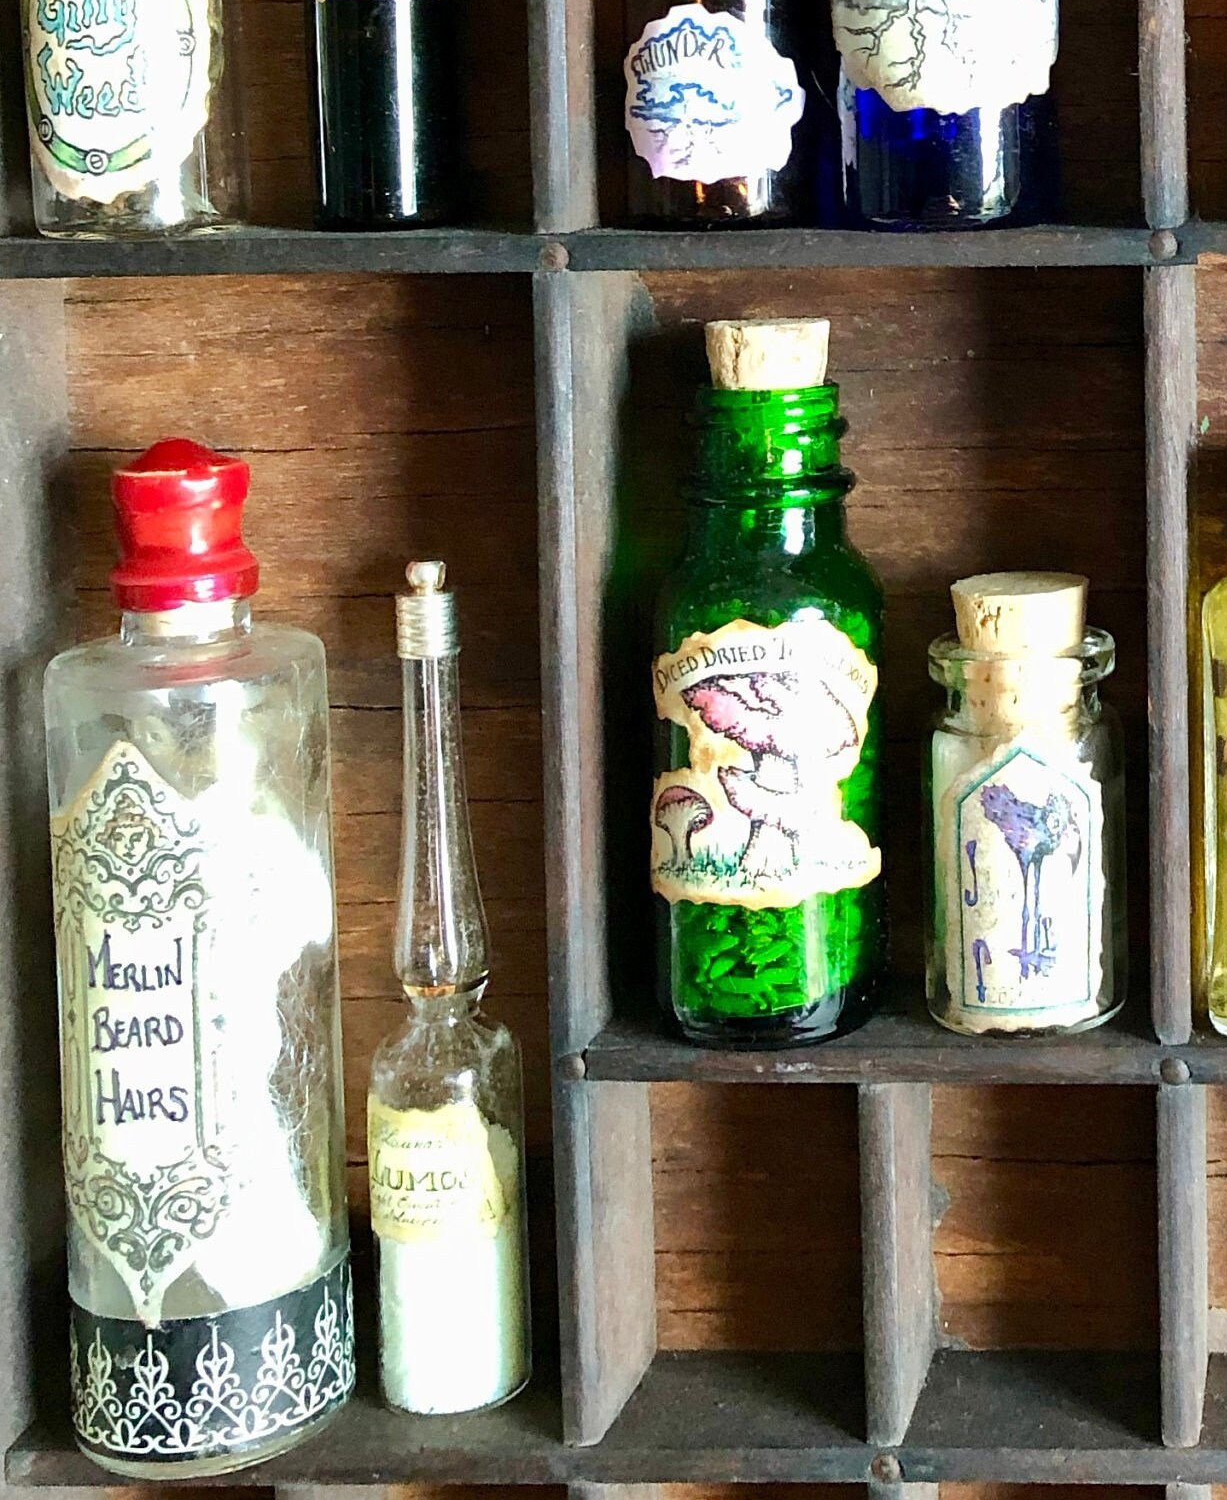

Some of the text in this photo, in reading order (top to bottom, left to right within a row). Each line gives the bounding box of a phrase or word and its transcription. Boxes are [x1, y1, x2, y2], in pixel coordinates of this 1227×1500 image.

[698, 643, 767, 670] DRIED
[86, 929, 184, 992] MERLIN
[91, 1005, 184, 1053] BEARD
[95, 1067, 190, 1126] HAIRS
